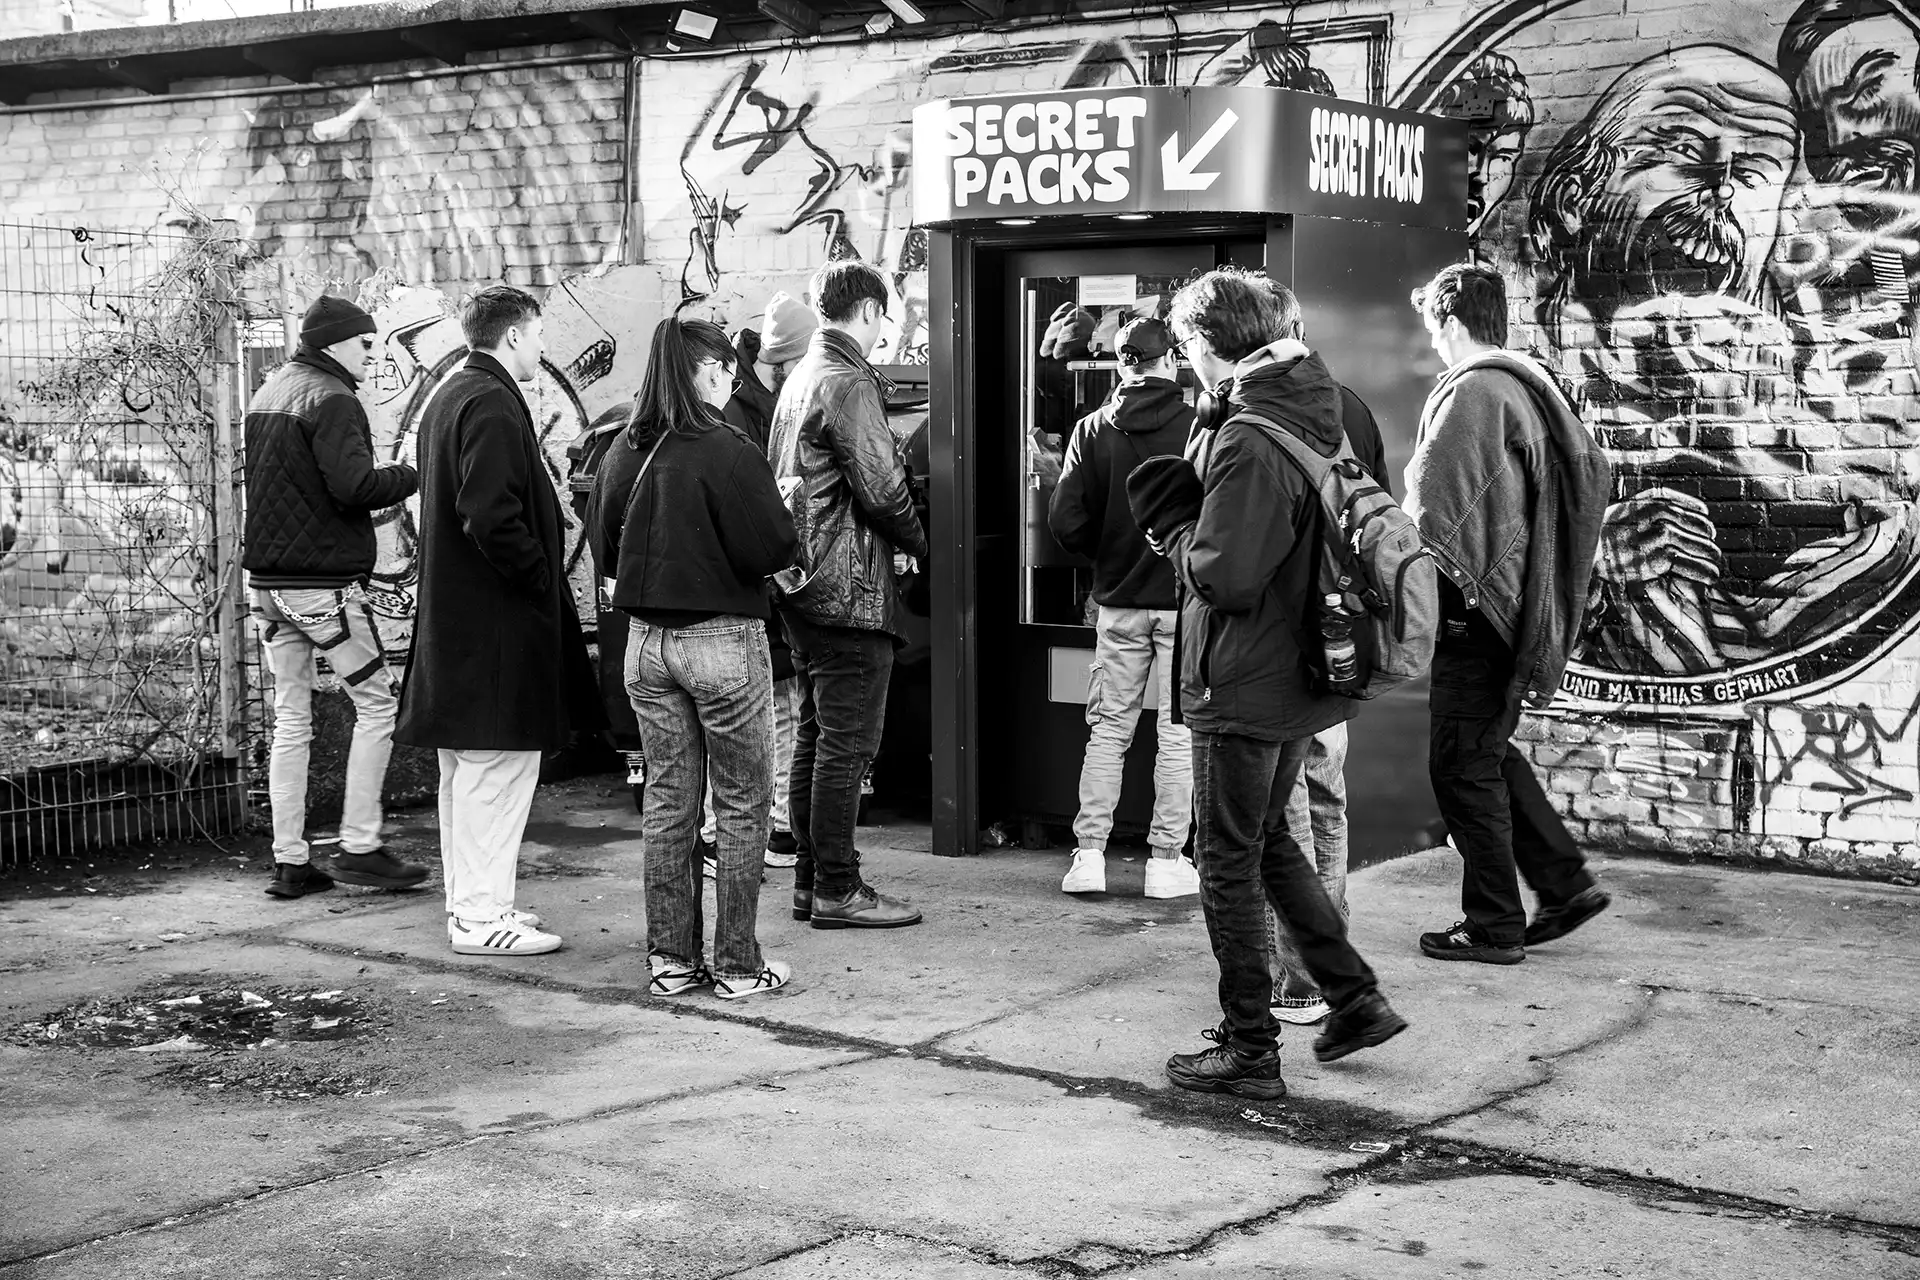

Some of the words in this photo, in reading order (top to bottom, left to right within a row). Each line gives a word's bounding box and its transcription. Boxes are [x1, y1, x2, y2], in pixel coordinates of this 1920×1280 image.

[946, 96, 1147, 157] SECRET
[1309, 107, 1370, 197] SECRET
[1373, 118, 1425, 204] PACKS
[953, 150, 1130, 207] PACKS
[1562, 673, 1600, 699] UND
[1608, 681, 1704, 704] MATTHIAS
[1714, 663, 1801, 701] GEPHART
